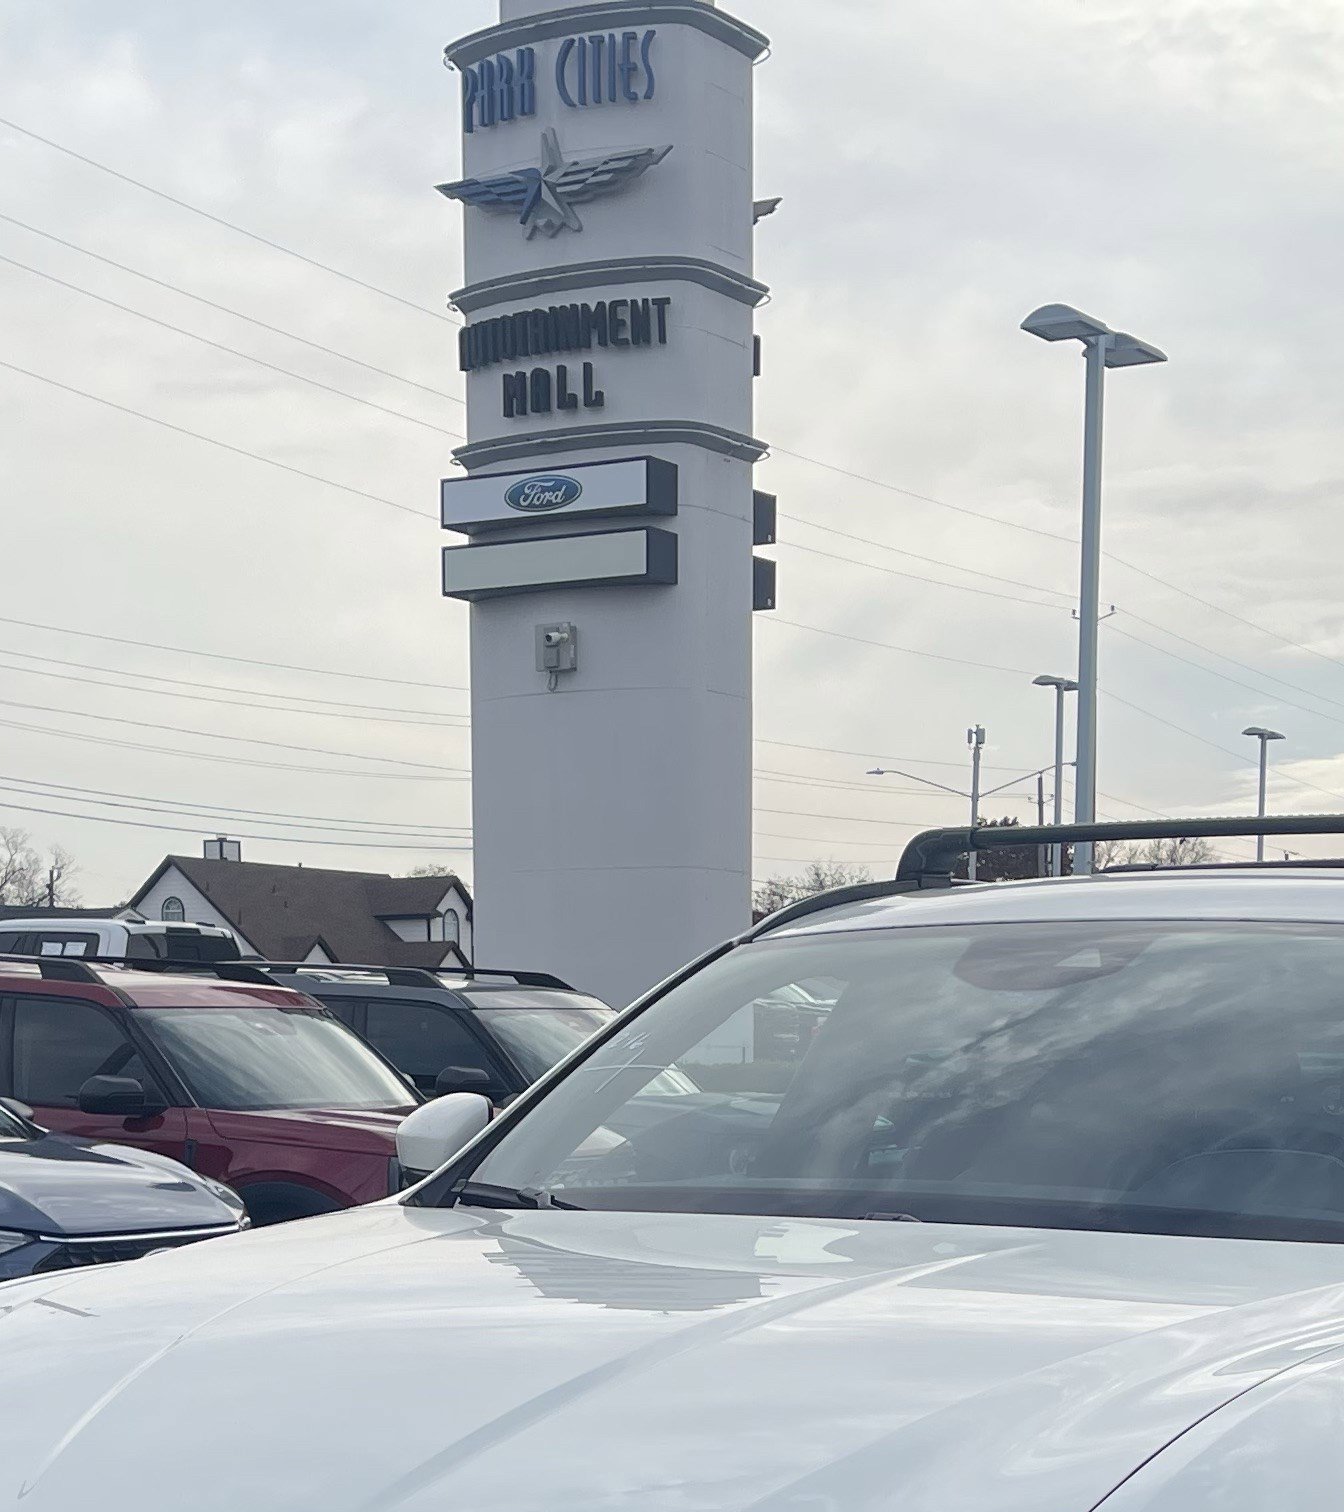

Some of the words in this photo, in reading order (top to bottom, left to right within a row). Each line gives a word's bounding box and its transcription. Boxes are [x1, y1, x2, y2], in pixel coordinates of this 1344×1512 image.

[462, 46, 535, 134] PARK
[555, 29, 657, 109] CITIES
[519, 480, 568, 507] Ford
